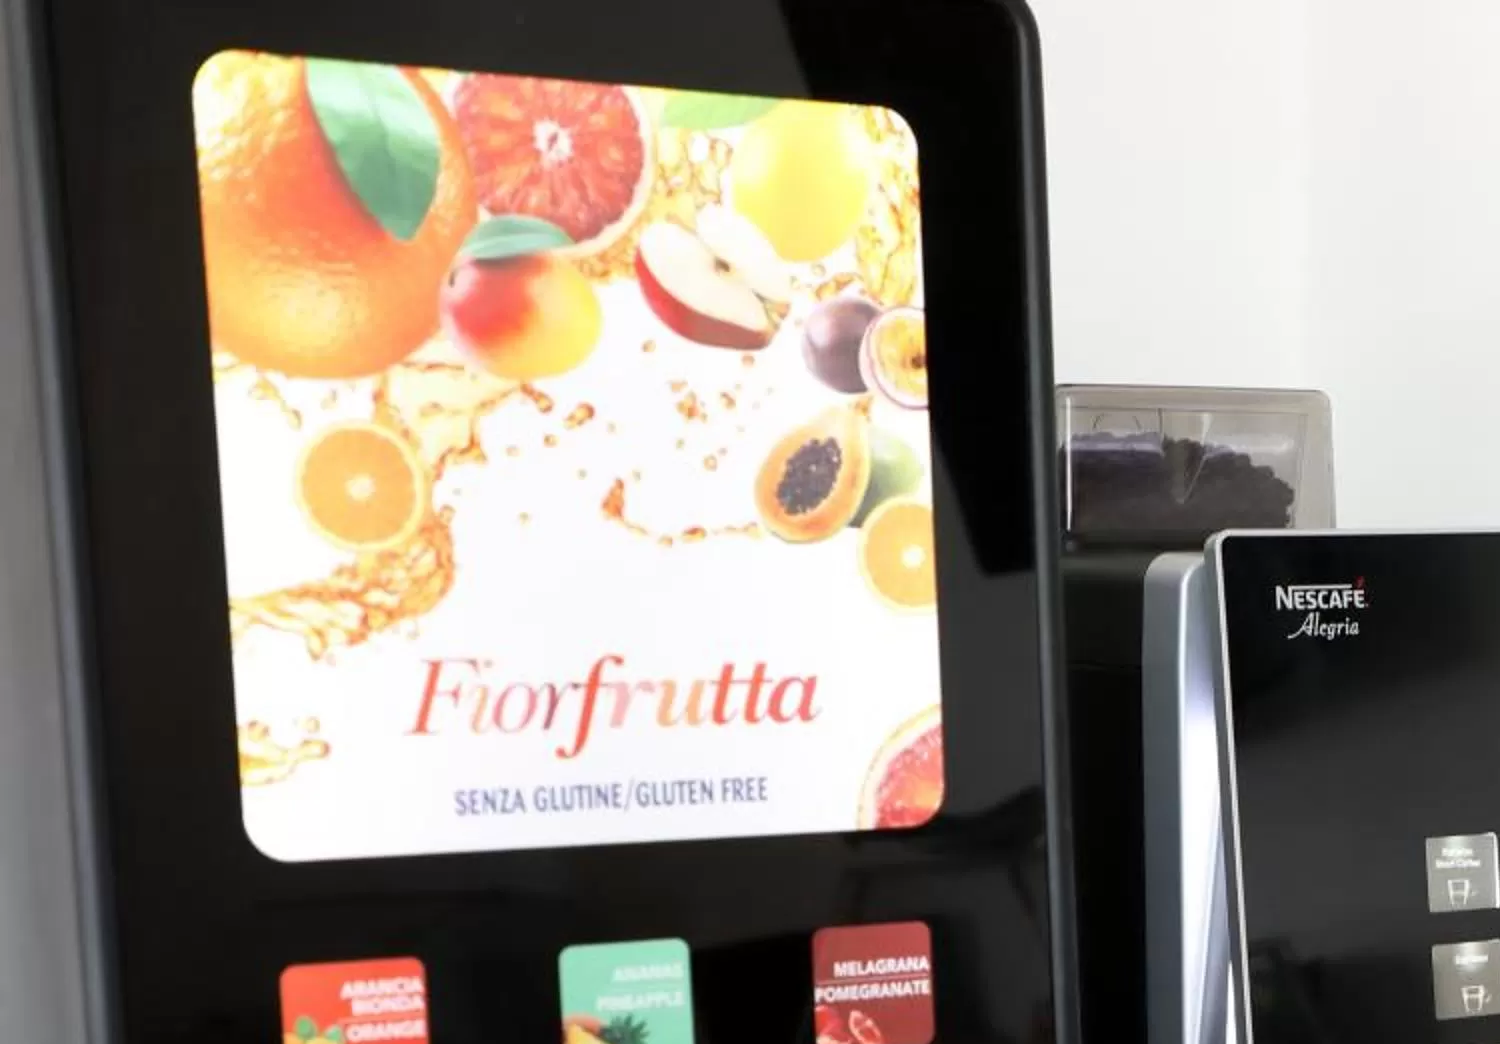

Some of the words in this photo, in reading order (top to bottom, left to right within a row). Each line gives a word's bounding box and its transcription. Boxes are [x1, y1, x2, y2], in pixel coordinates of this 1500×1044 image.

[1287, 611, 1360, 640] Alegria
[403, 654, 821, 759] Fiorfrutta
[454, 789, 527, 816] SENZA
[533, 779, 715, 813] GLUTINE/GLUTEN
[721, 776, 768, 803] FREE
[833, 955, 930, 978] MELAGRANA
[340, 976, 425, 1000] ARANCIA
[814, 979, 931, 1004] POMEGRANATE
[346, 1019, 426, 1043] ORANGE
